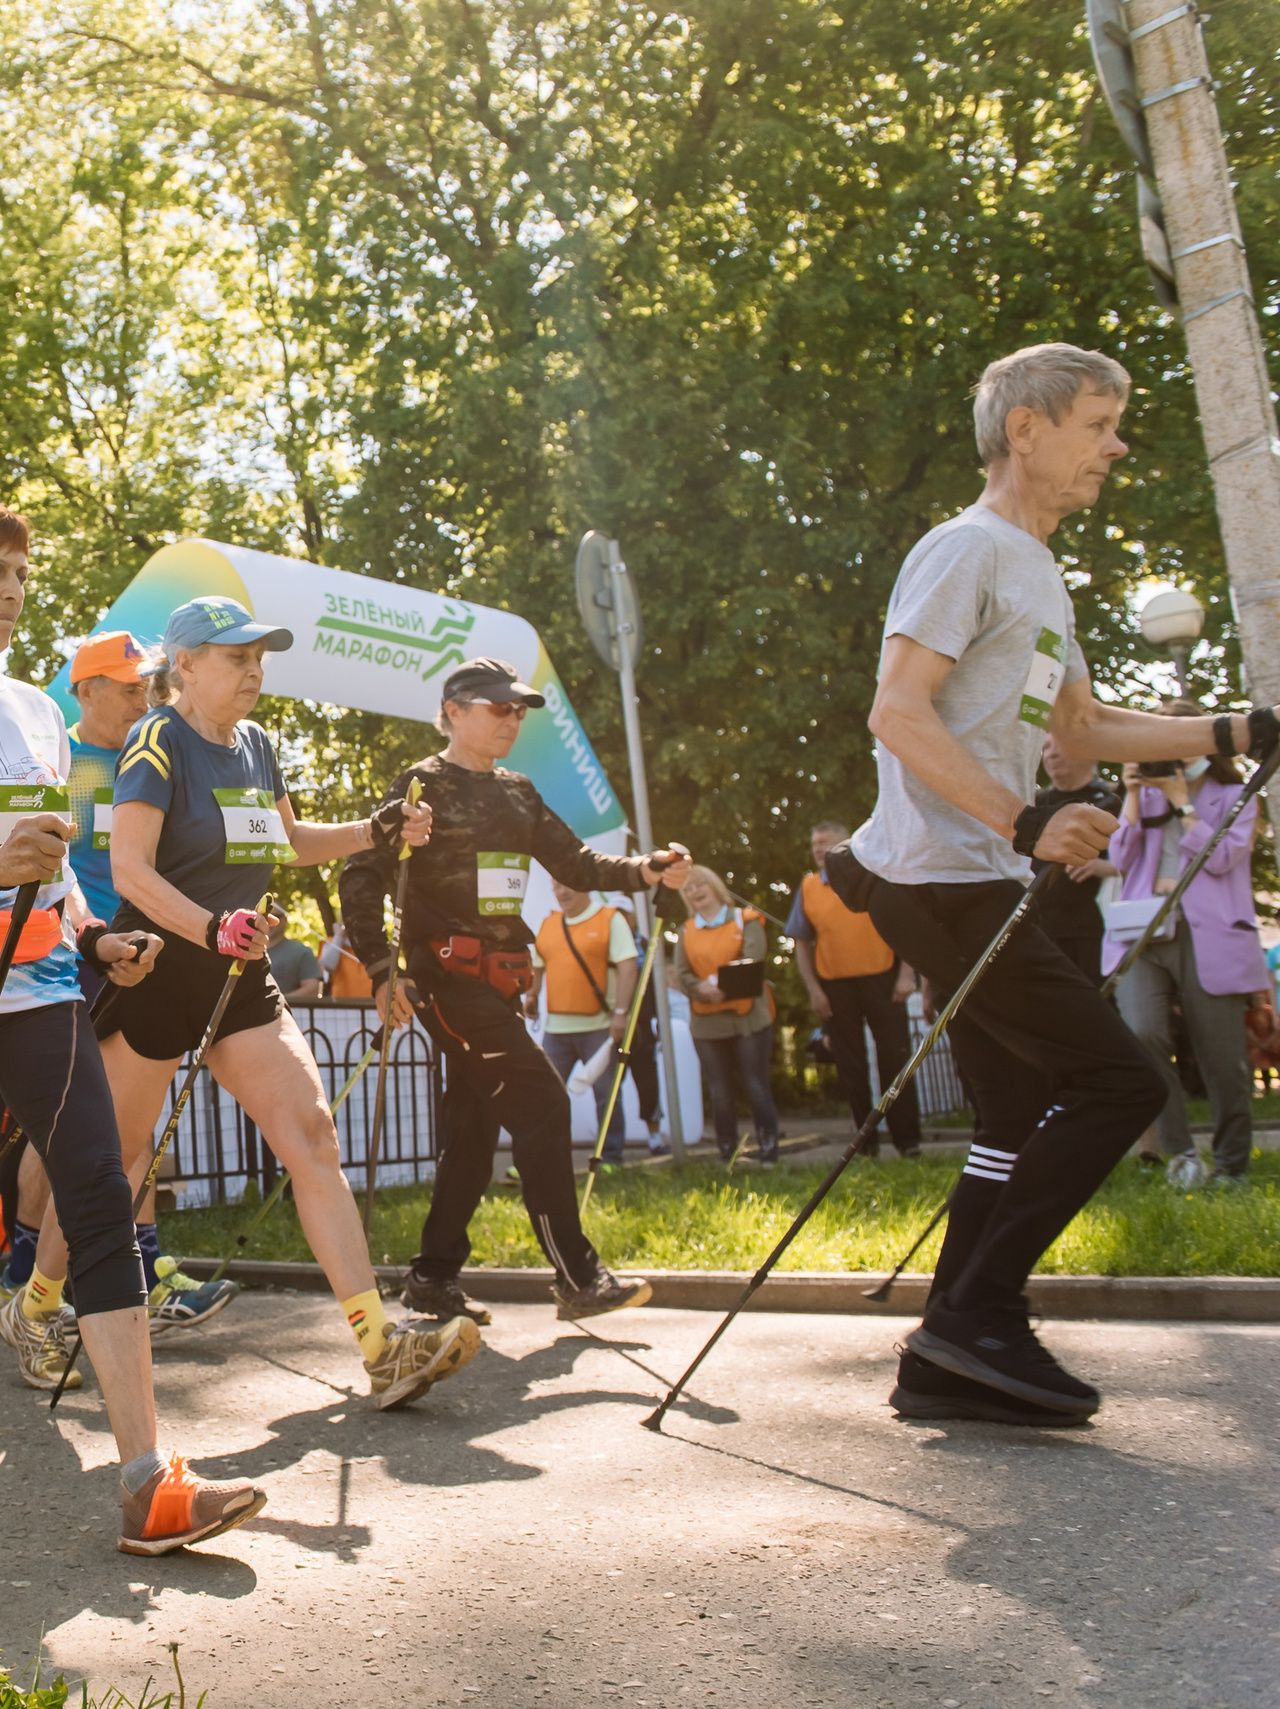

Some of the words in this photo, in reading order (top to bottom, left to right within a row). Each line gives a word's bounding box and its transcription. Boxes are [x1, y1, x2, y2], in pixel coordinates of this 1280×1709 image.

[324, 593, 425, 634] ЗЕЛЁНЫЙ
[313, 632, 423, 673] МАРАФОН
[543, 681, 612, 816] ФИНИШ
[248, 819, 268, 834] 362
[392, 906, 403, 948] LEKI
[169, 1088, 191, 1129] ELITE
